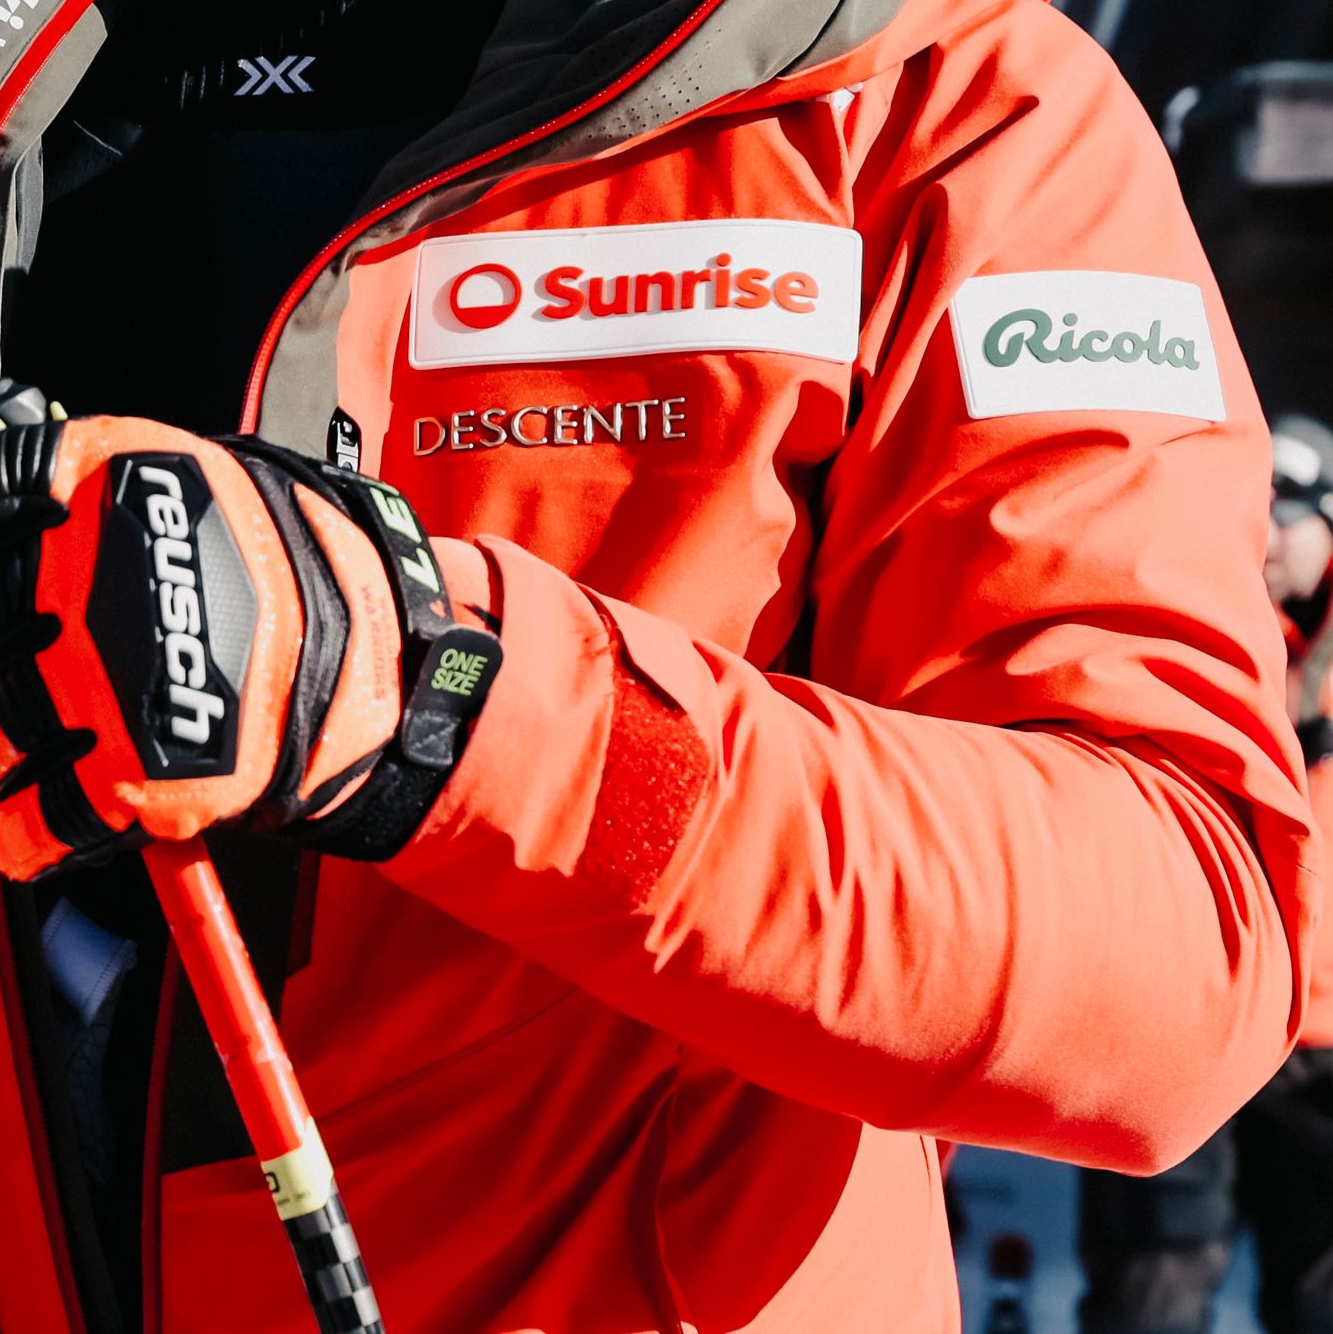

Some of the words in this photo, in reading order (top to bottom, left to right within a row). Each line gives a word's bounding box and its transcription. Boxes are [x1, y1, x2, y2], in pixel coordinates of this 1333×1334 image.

[540, 253, 819, 320] Sunrise
[983, 308, 1201, 371] Ricola
[413, 397, 687, 458] DESCENTE
[137, 465, 227, 745] reusch
[431, 667, 479, 696] SIZE
[440, 648, 488, 676] ONE
